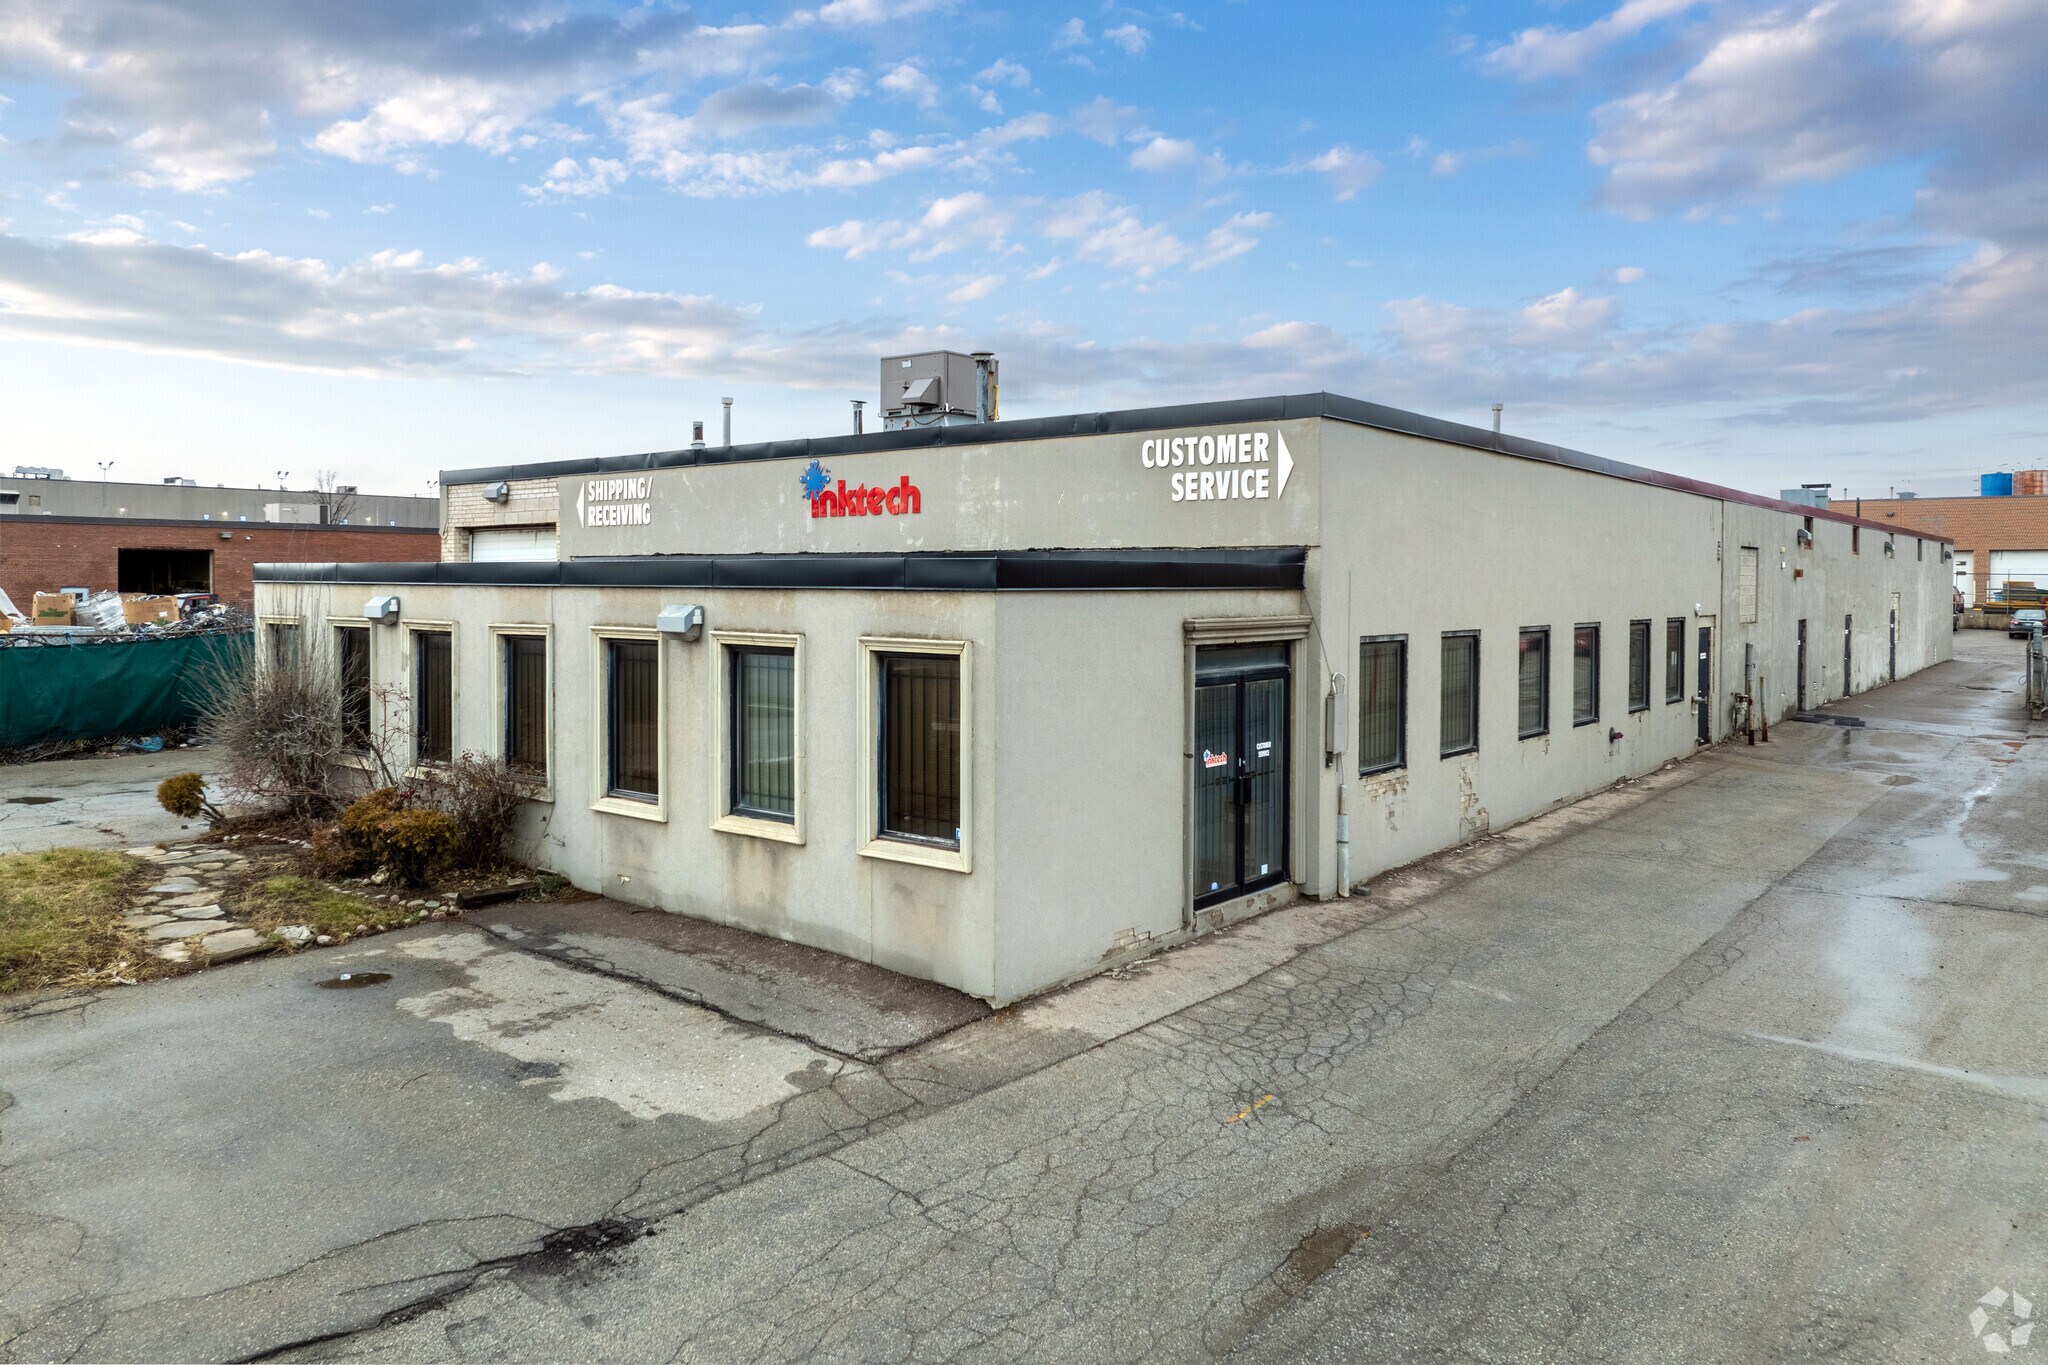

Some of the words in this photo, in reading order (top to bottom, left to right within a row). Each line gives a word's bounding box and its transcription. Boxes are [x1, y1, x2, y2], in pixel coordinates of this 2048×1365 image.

[1142, 432, 1269, 468] CUSTOMER
[588, 477, 653, 502] SHIPPING/
[811, 475, 921, 518] inktech
[1171, 468, 1269, 502] SERVICE
[588, 503, 651, 527] RECEIVING
